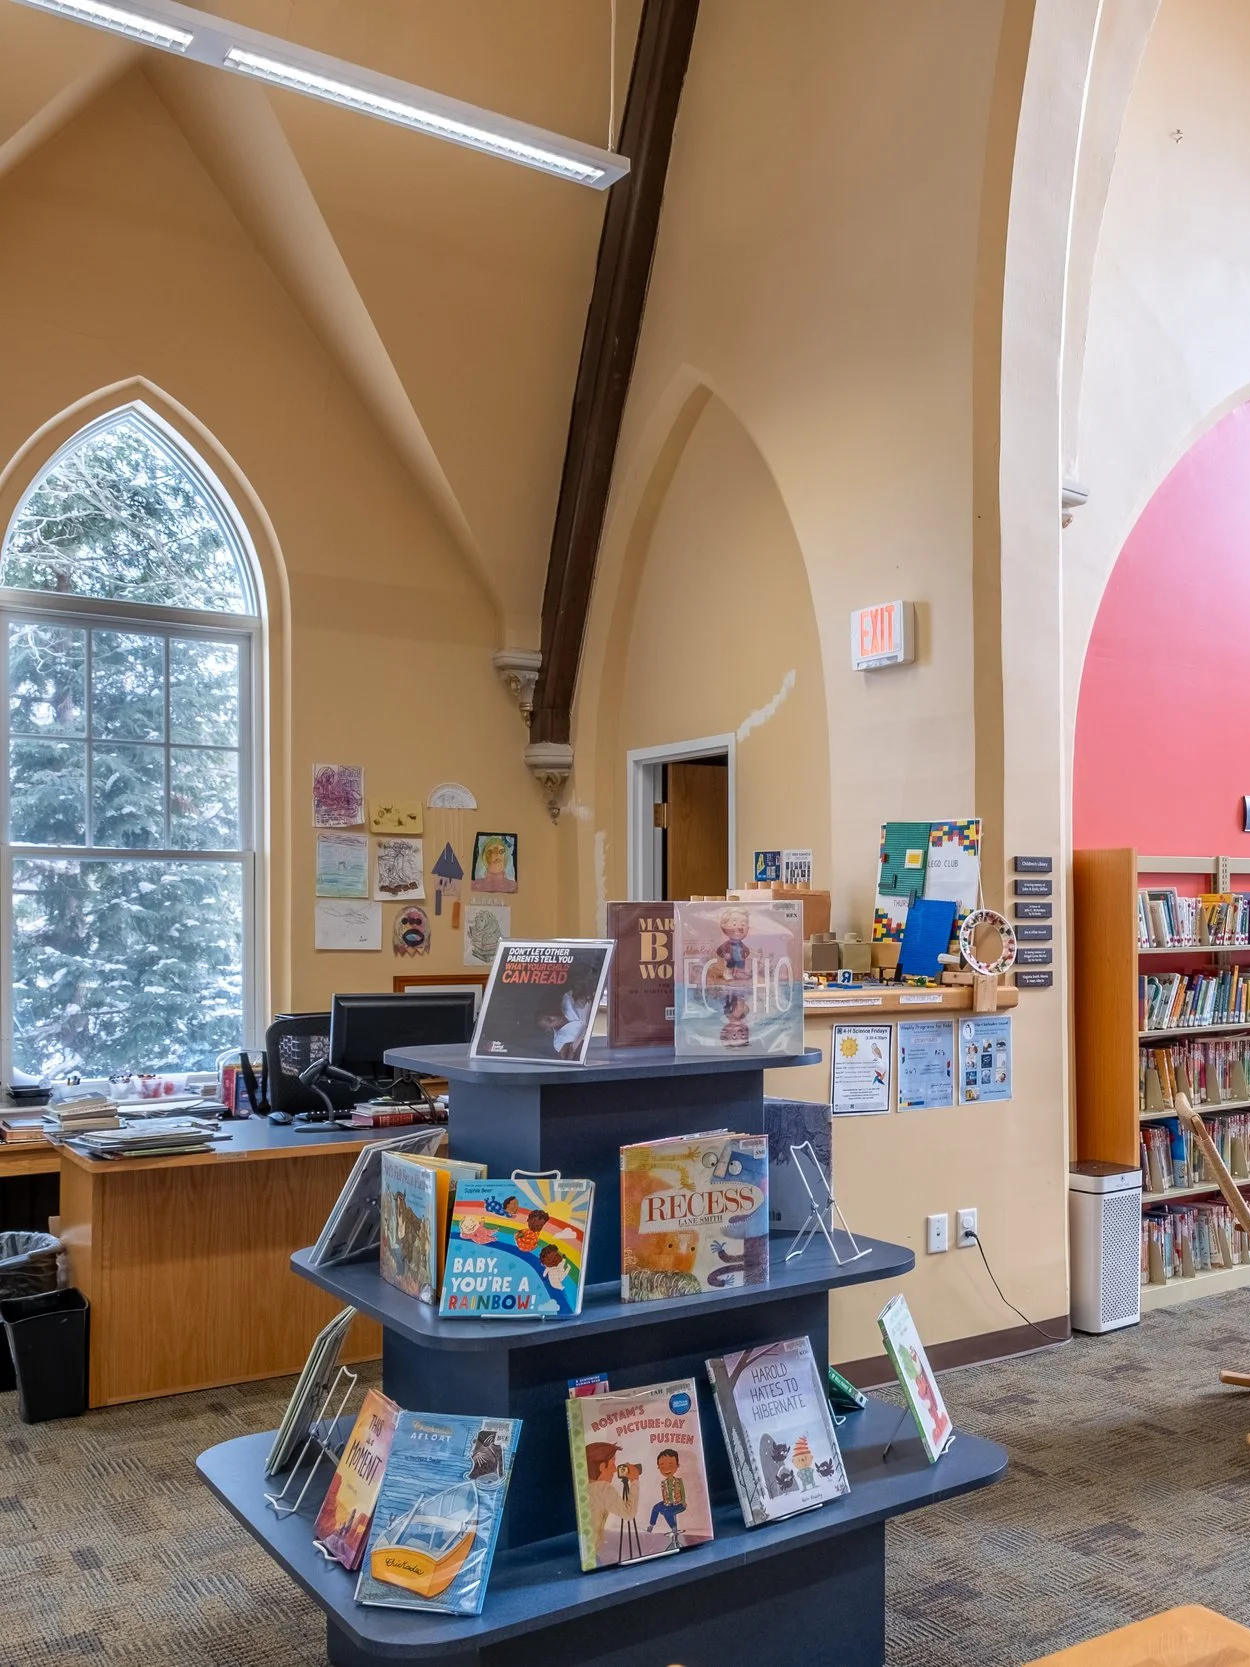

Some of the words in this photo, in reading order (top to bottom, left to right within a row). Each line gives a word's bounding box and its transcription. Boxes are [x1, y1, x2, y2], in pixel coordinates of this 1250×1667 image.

[860, 604, 895, 657] EXIT
[927, 860, 941, 868] LEGO
[944, 860, 959, 868] CLUB
[893, 900, 909, 908] THURS
[638, 918, 674, 931] MAR
[545, 948, 570, 956] OTHER
[547, 963, 570, 971] CHILD
[502, 971, 530, 983] CAN
[531, 971, 568, 984] READ
[683, 956, 794, 1014] ECHO
[644, 1186, 756, 1222] RECESS
[678, 1217, 698, 1225] LANE
[700, 1215, 723, 1223] SMITH
[453, 1257, 498, 1274] BABY,
[451, 1277, 512, 1292] YOU'RE
[518, 1277, 530, 1292] A
[448, 1294, 536, 1310] RAINBOW!
[751, 1362, 787, 1384] HAROLD
[750, 1381, 784, 1403] HATES
[784, 1377, 799, 1393] TO
[752, 1394, 807, 1421] HIBERNATE
[369, 1414, 384, 1437] THIS
[590, 1404, 645, 1432] ROSTAM'S
[616, 1418, 686, 1437] PICTURE-DAY
[410, 1432, 452, 1442] AFLOAT
[650, 1433, 695, 1445] PUSTEEN
[346, 1440, 382, 1486] MOMENT
